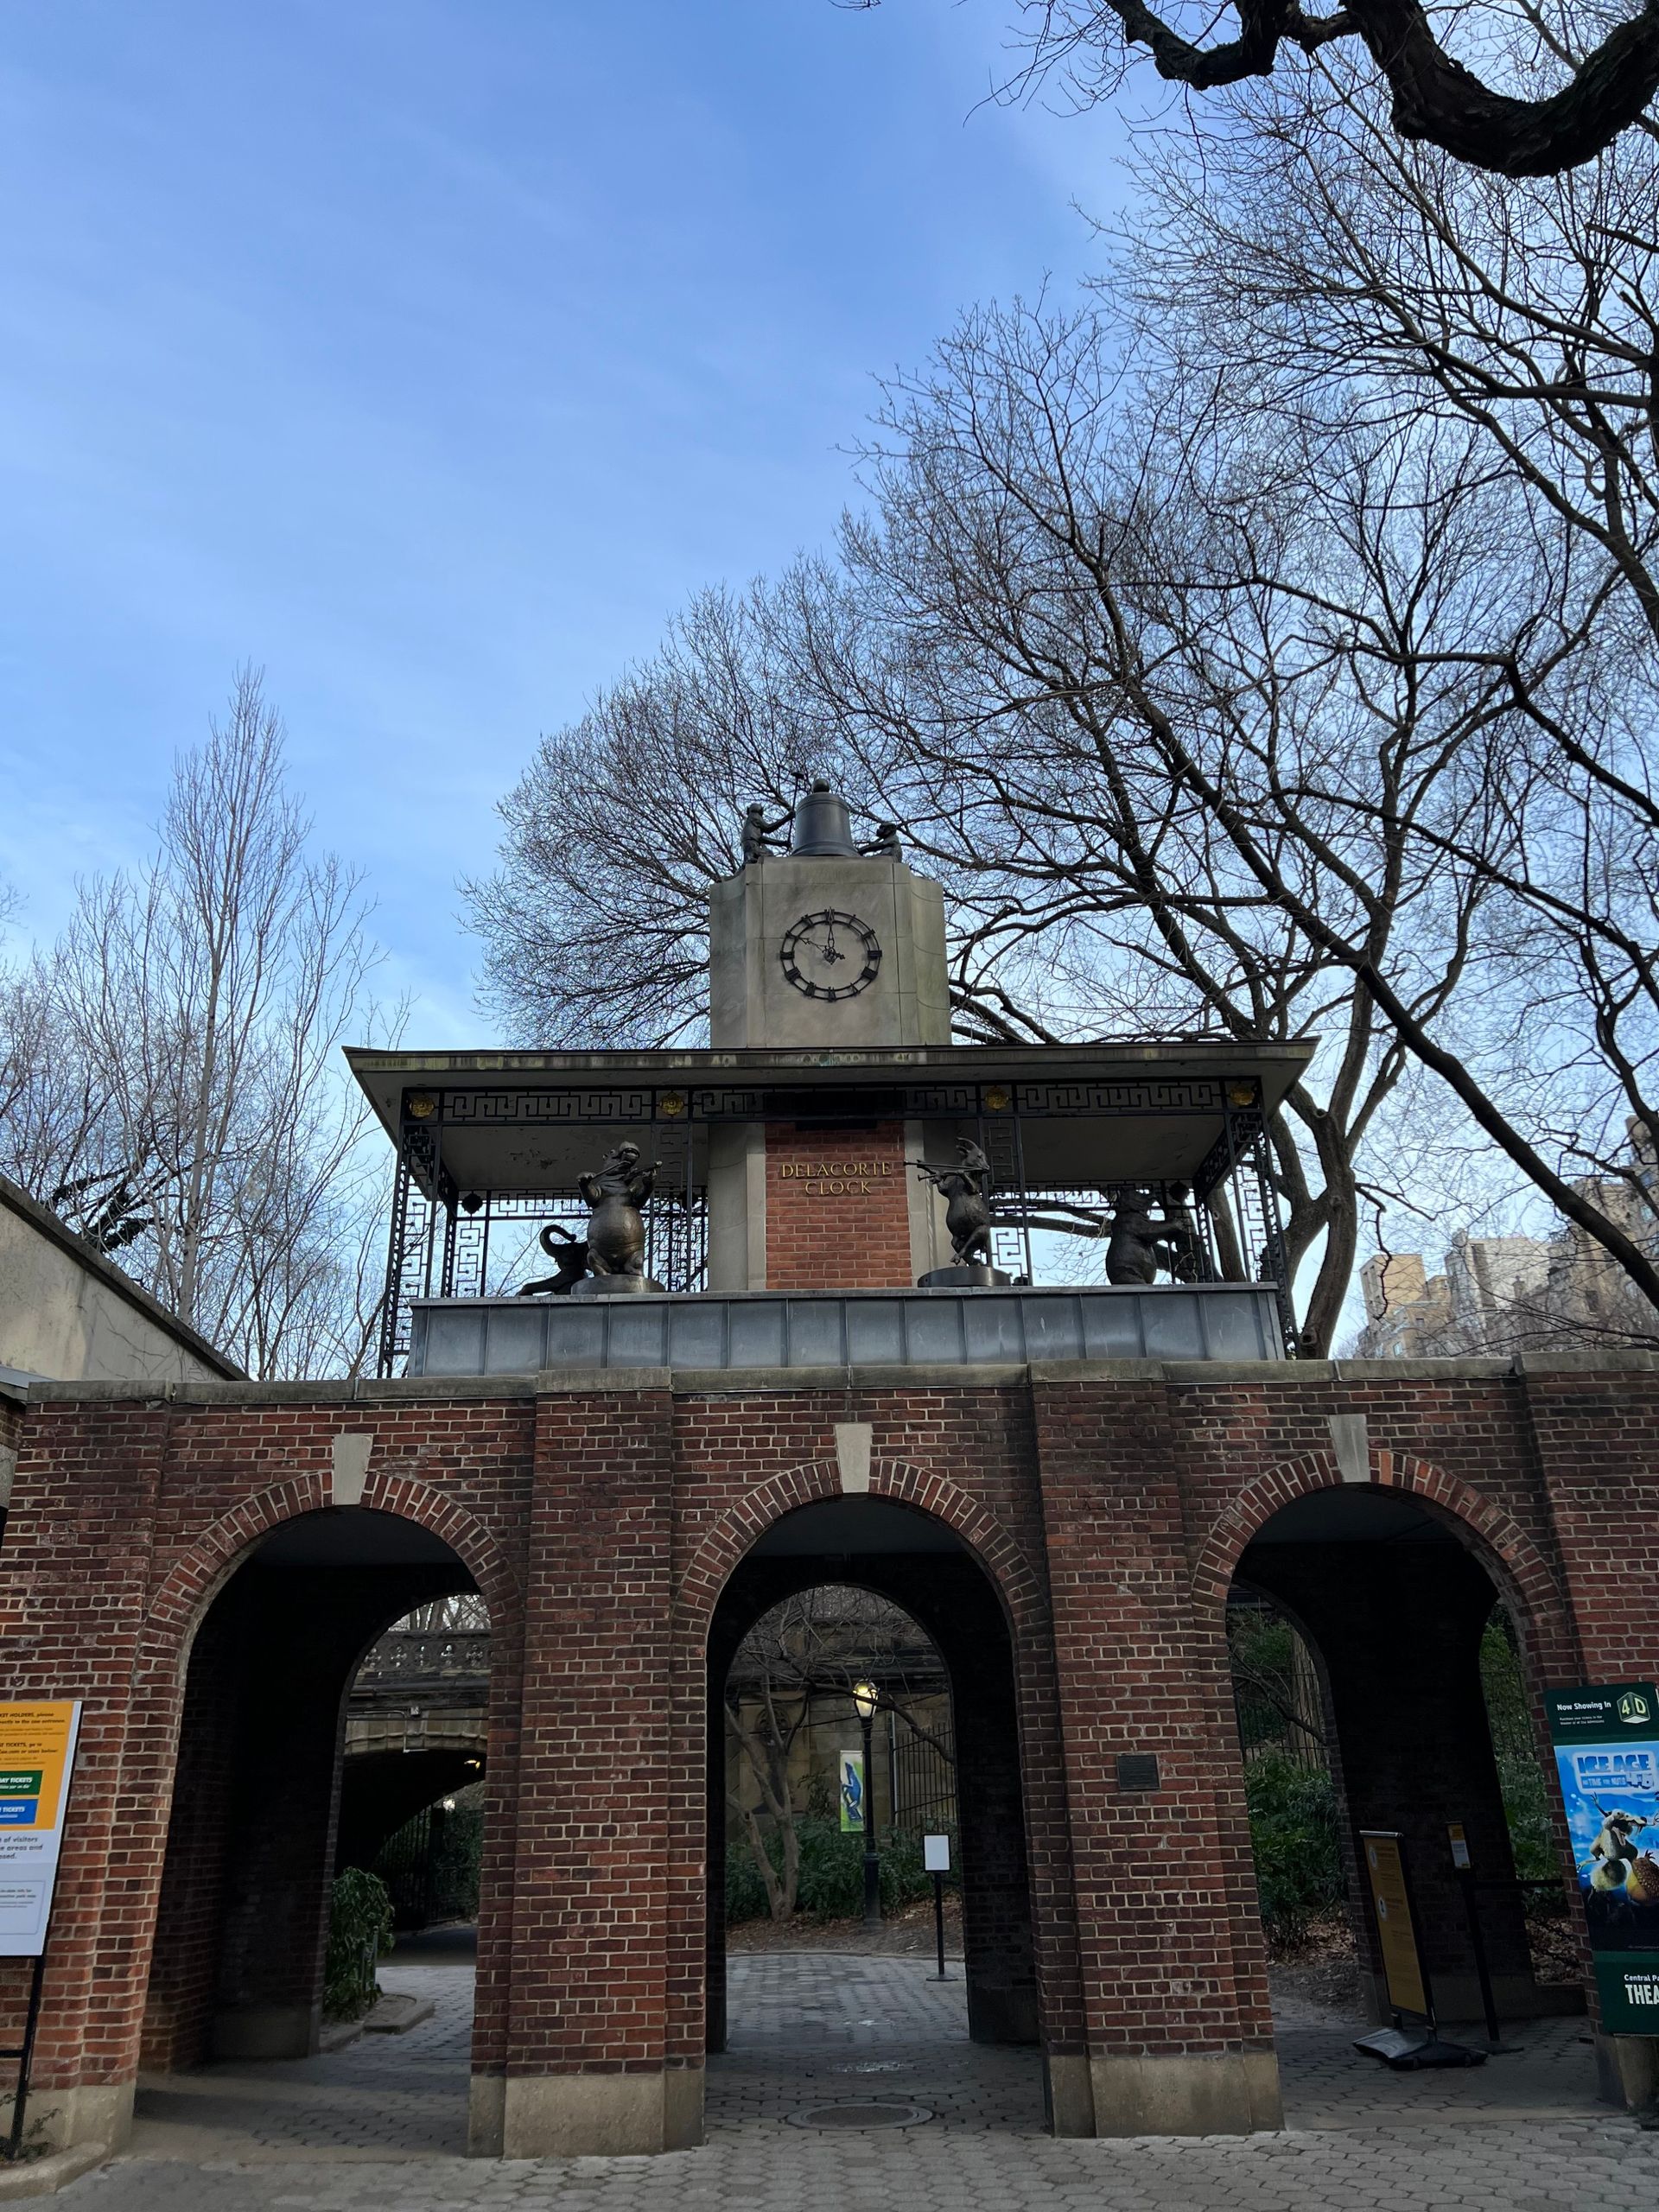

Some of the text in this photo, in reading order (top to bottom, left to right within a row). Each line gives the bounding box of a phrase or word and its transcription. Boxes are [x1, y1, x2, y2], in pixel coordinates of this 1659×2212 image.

[782, 1162, 892, 1178] DELACORTE
[805, 1181, 871, 1195] CLOCK
[1573, 1701, 1603, 1711] Showing
[1577, 1754, 1651, 1774] ICE AGE
[1624, 1974, 1651, 1982] Central
